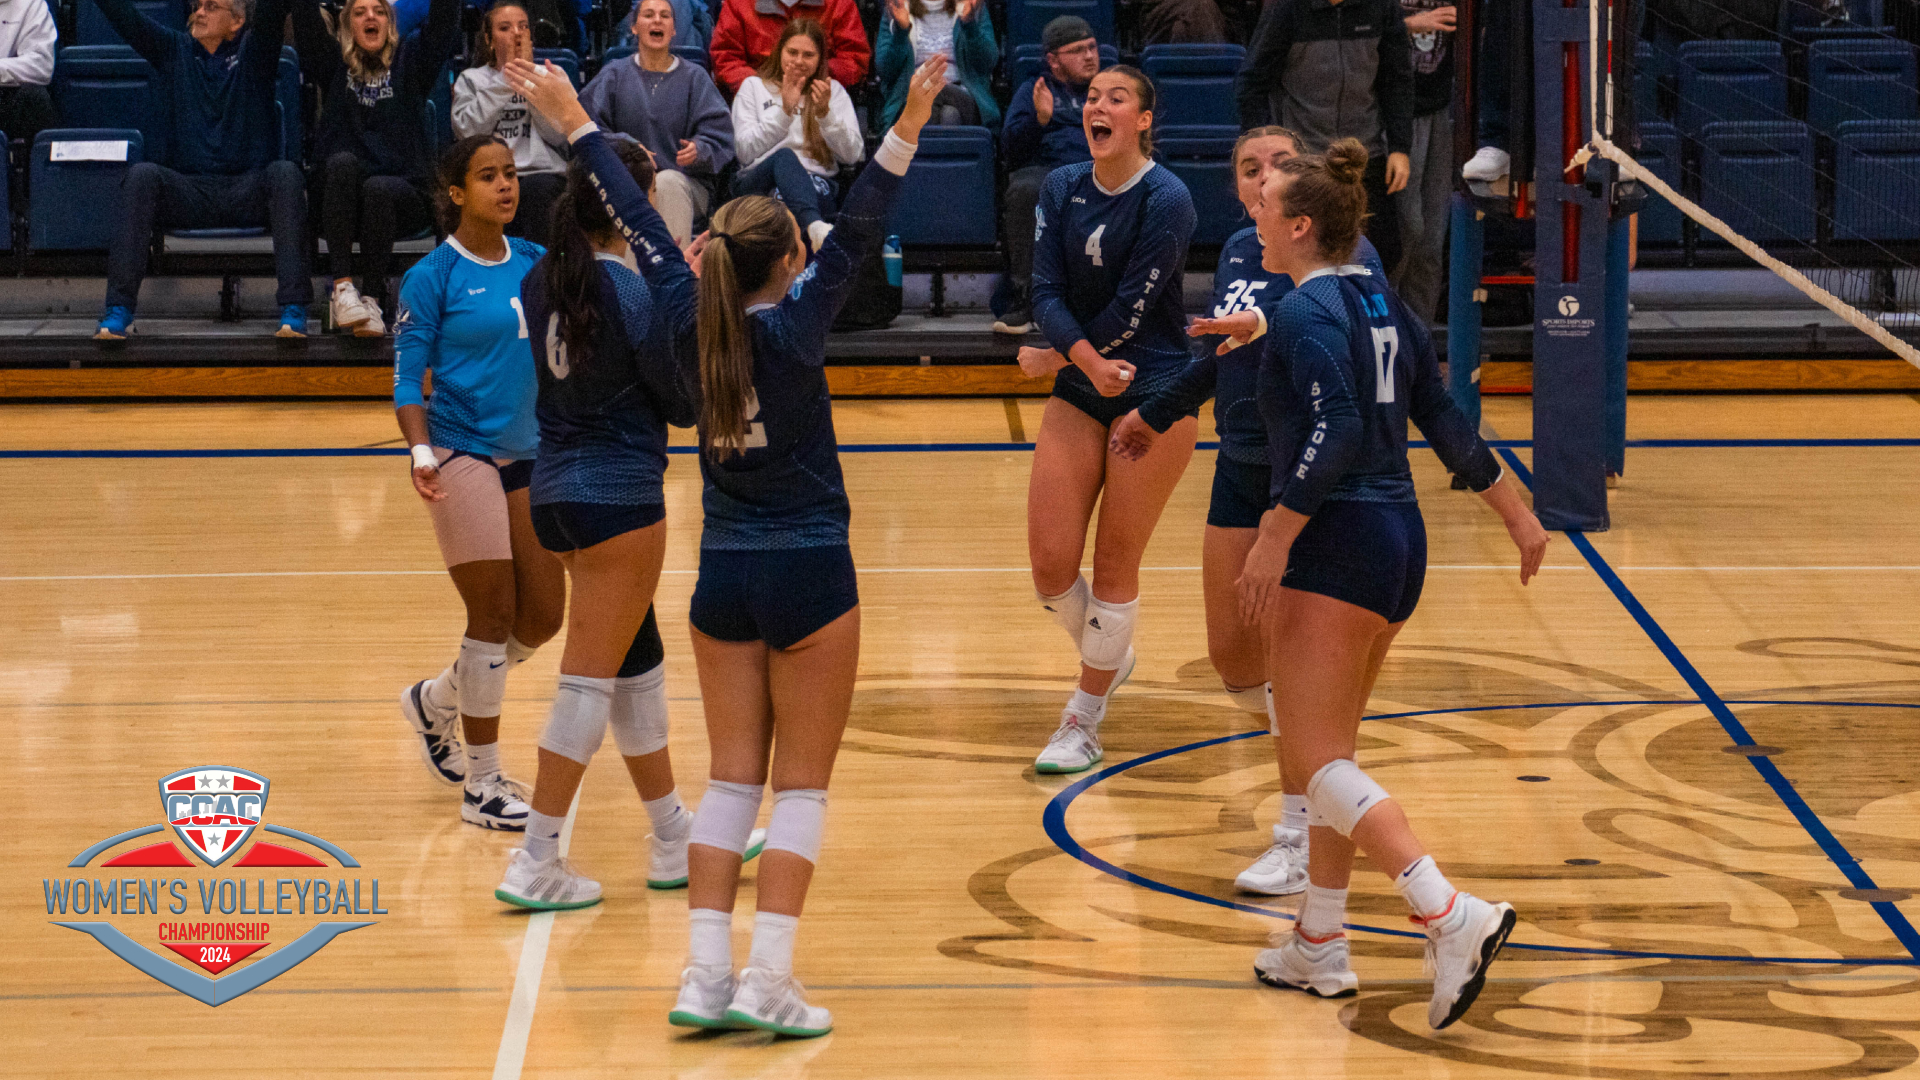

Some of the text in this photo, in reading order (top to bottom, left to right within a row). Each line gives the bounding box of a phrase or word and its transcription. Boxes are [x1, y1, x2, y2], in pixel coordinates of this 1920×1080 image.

[1085, 224, 1104, 267] 4
[510, 296, 529, 339] 1
[1214, 278, 1269, 318] 35
[1542, 318, 1596, 326] SPORTS IMPORTS
[546, 310, 570, 380] 6
[1370, 326, 1399, 403] 17
